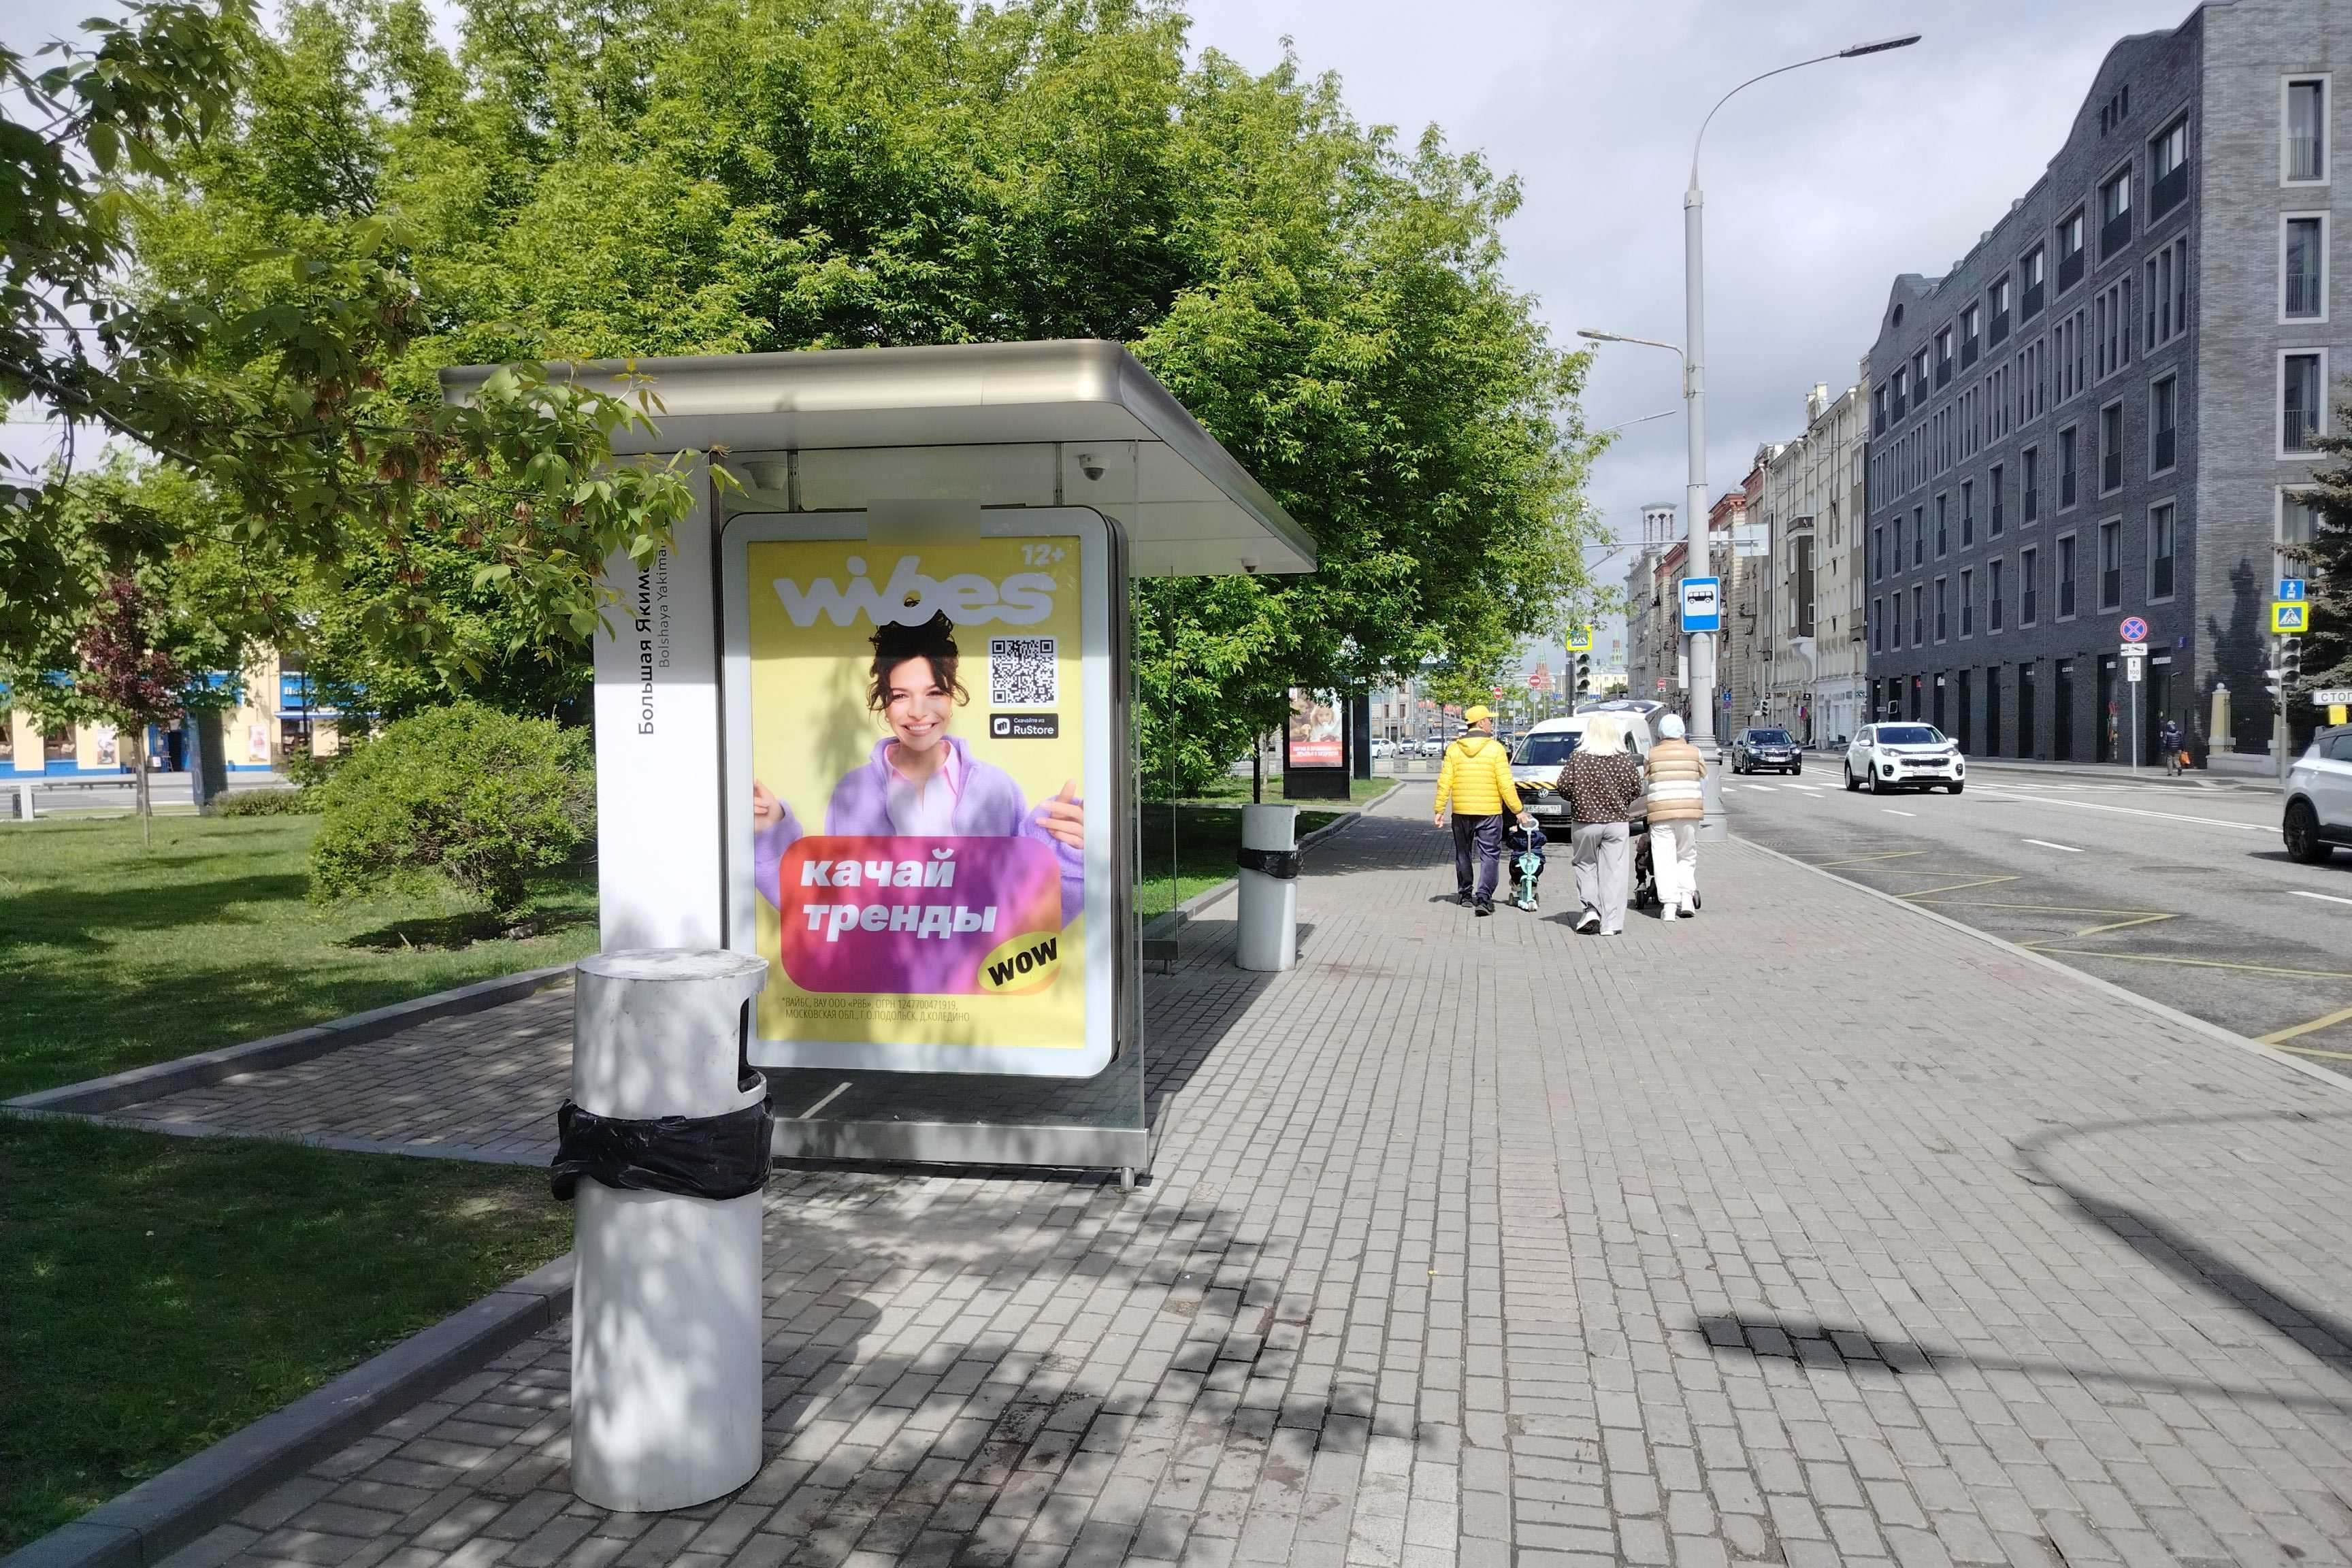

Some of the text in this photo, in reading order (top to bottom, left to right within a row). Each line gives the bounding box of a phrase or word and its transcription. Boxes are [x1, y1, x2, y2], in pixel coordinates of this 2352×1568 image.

[1022, 544, 1066, 567] 12+
[657, 605, 670, 668] Bolshaya
[638, 640, 654, 734] Большая
[1013, 725, 1054, 734] RuStore
[800, 848, 956, 887] качай
[803, 904, 997, 942] тренды
[785, 1009, 836, 1019] МОСКОВСКАЯ
[814, 998, 827, 1008] ВАУ
[830, 998, 846, 1008] ООО
[876, 999, 896, 1009] ОГРН
